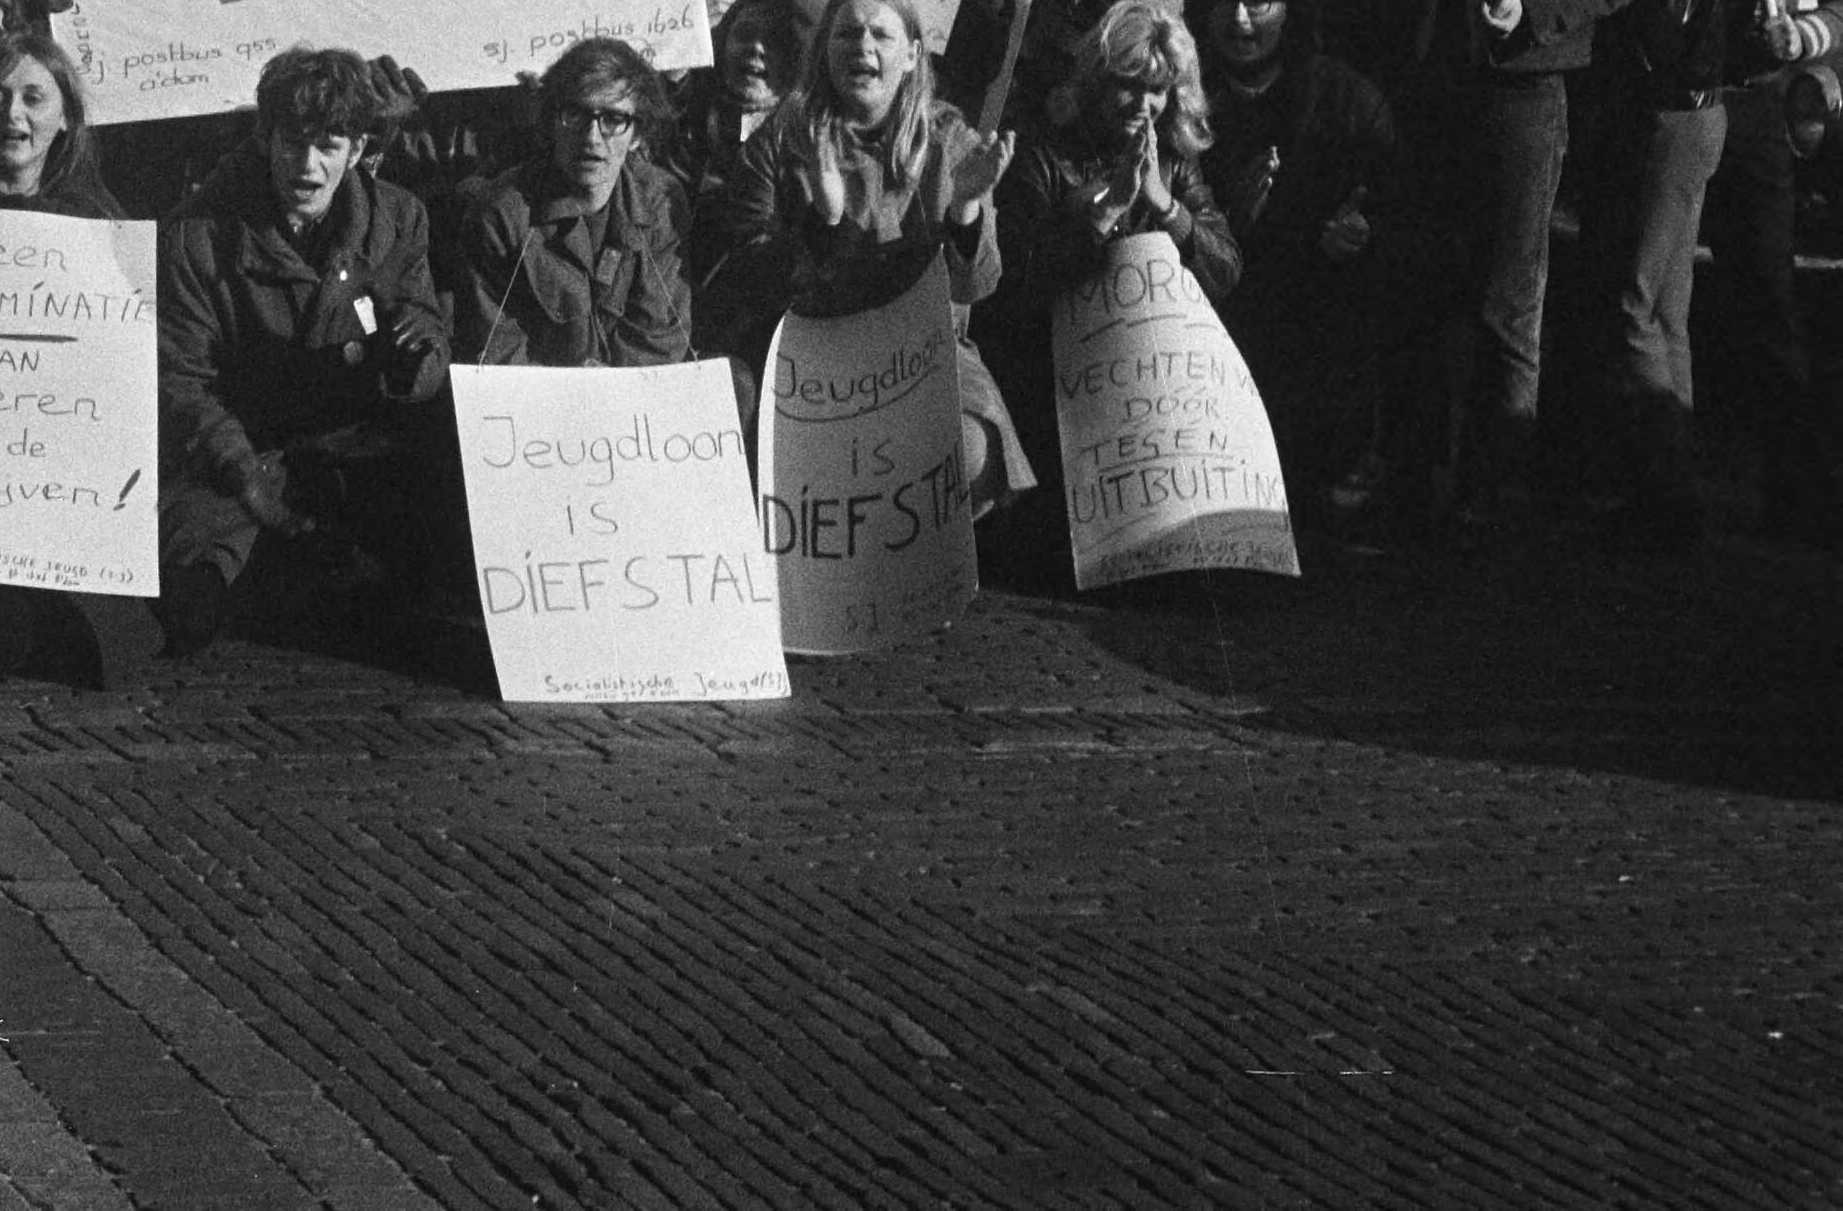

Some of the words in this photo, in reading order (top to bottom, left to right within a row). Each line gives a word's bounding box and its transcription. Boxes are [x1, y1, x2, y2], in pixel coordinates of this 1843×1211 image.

[529, 16, 635, 58] postbus
[123, 40, 223, 79] postbus
[1060, 351, 1226, 400] VECHTEN
[7, 427, 47, 458] de
[480, 412, 748, 488] Jeugdloon
[851, 436, 896, 477] is
[564, 492, 621, 538] is
